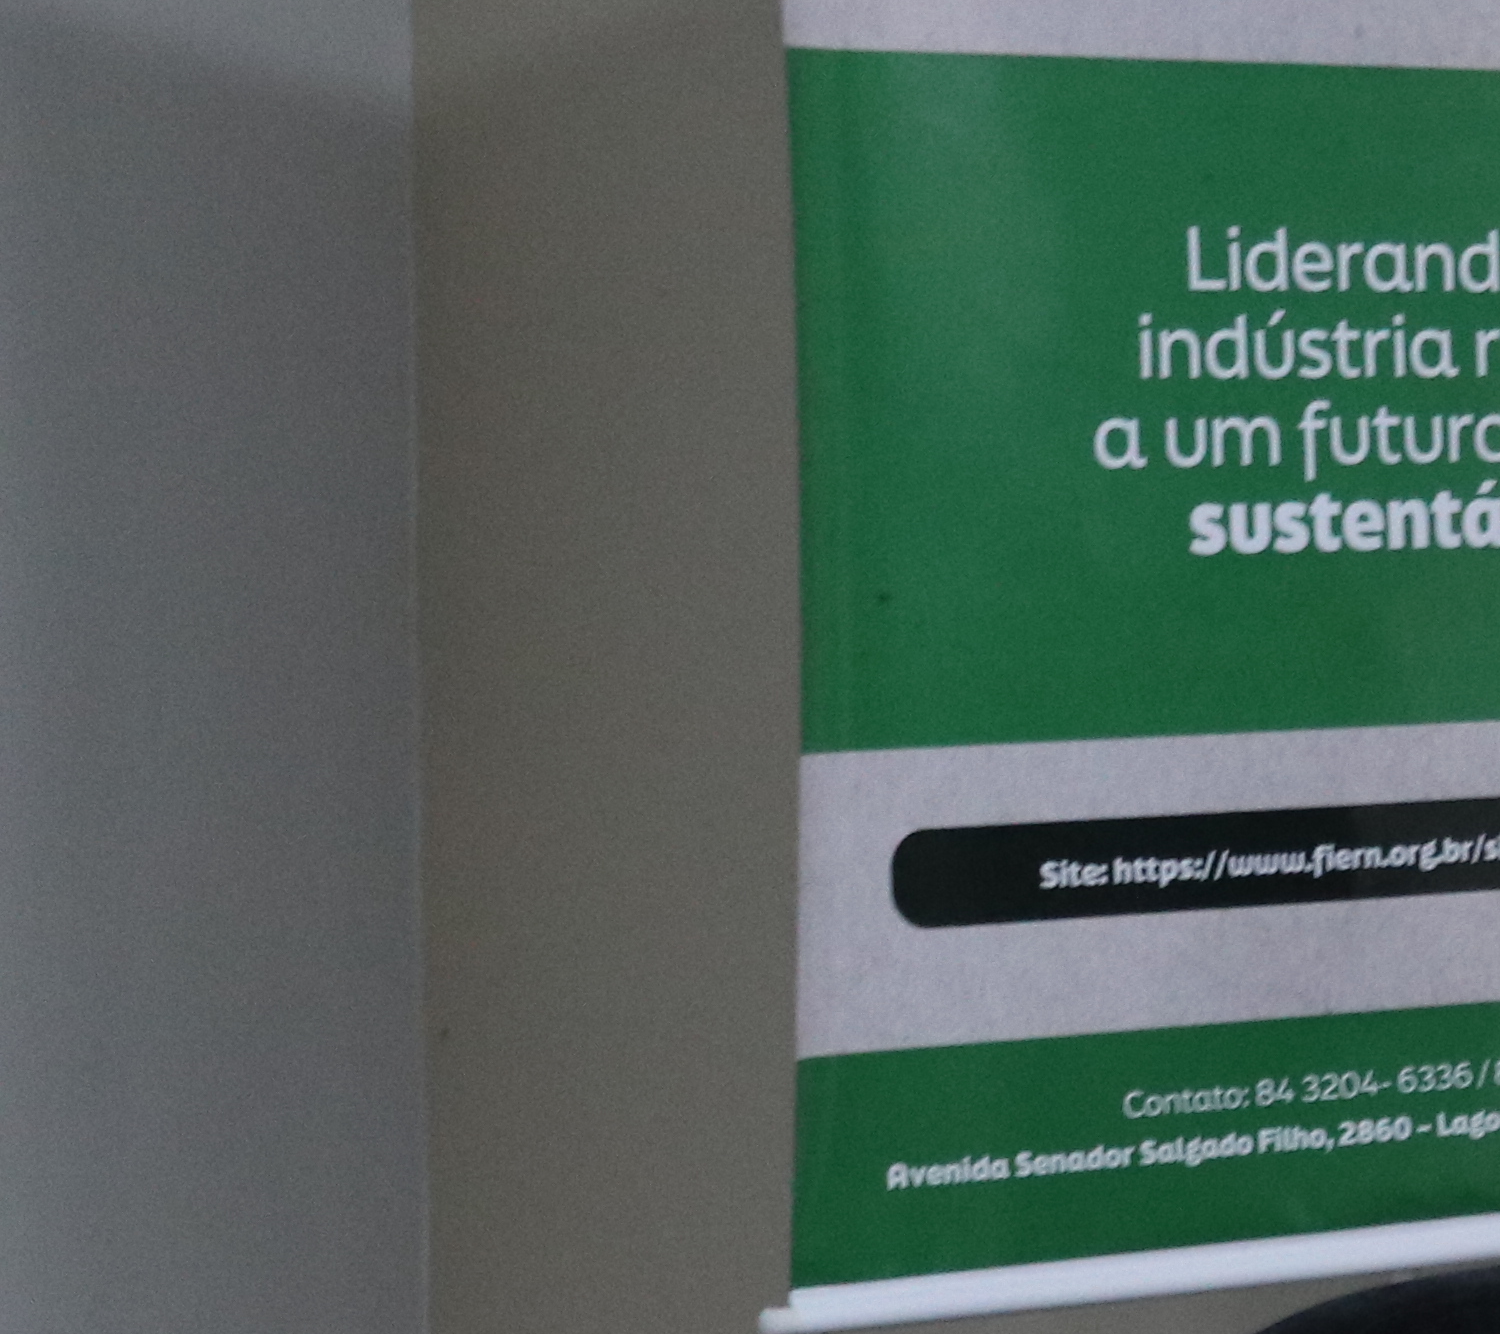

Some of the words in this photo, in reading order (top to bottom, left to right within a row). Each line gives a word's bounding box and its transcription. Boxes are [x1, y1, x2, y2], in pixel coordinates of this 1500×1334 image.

[1137, 309, 1460, 380] indústria
[1093, 415, 1148, 470] a
[1164, 414, 1282, 469] um
[1038, 858, 1109, 890] Site:
[1121, 1084, 1250, 1119] Contato:
[1254, 1076, 1296, 1108] 84
[1395, 1059, 1474, 1095] 6336
[1476, 1058, 1491, 1089] /
[885, 1154, 1012, 1192] Avenida
[1013, 1142, 1137, 1178] Senador
[1138, 1130, 1255, 1168] Salgado
[1256, 1125, 1336, 1154] Filho,
[1336, 1113, 1414, 1148] 2860
